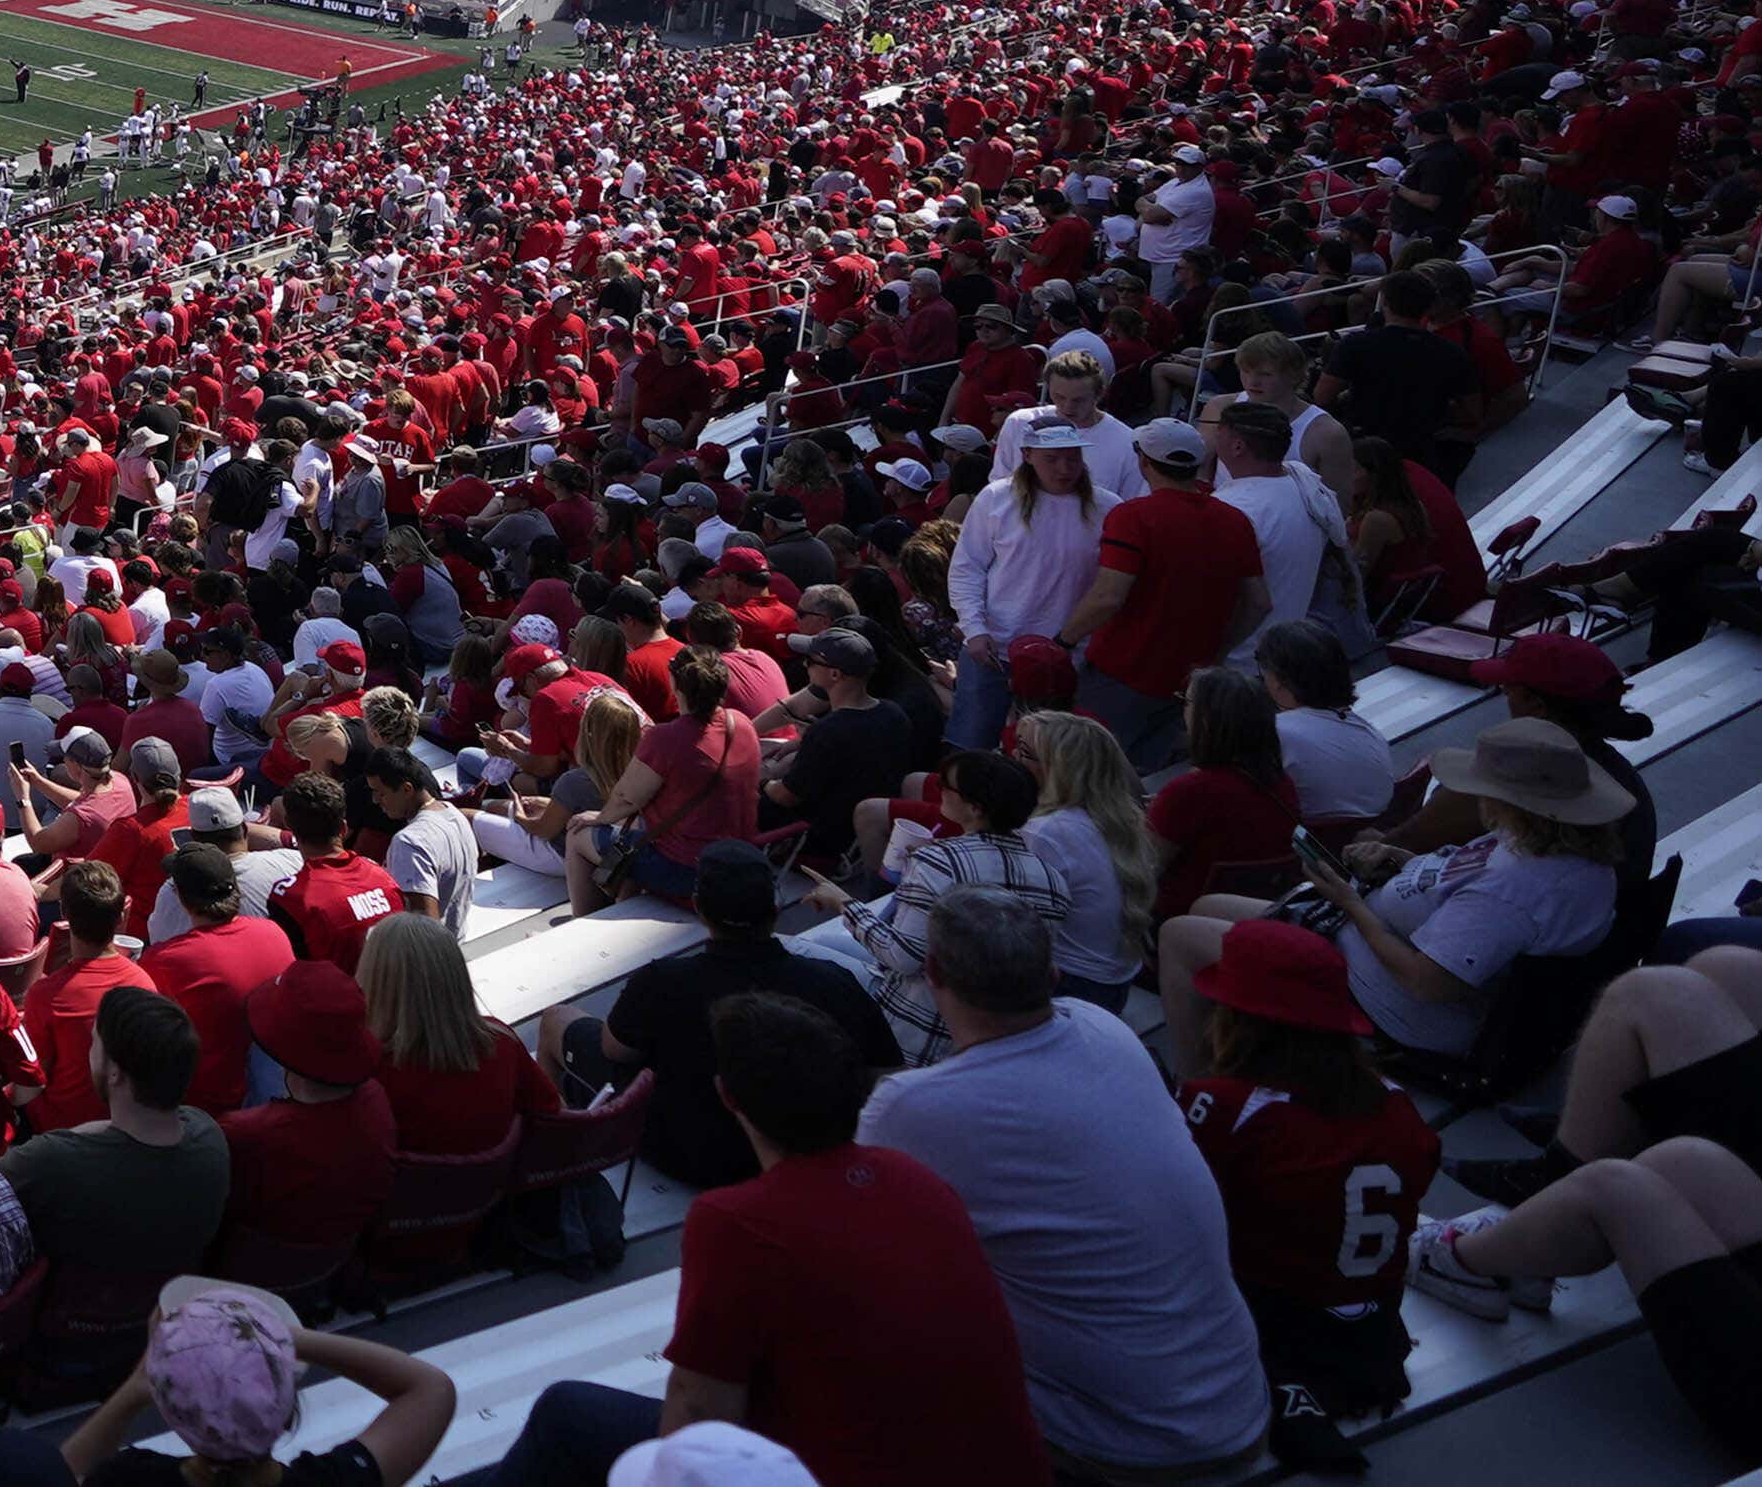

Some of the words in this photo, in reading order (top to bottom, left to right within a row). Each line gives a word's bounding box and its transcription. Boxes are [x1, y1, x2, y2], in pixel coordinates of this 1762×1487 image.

[274, 875, 298, 897] 2
[347, 887, 391, 921] MOSS
[1188, 1091, 1214, 1125] 6
[1336, 1163, 1402, 1278] 6
[1278, 1384, 1326, 1418] A
